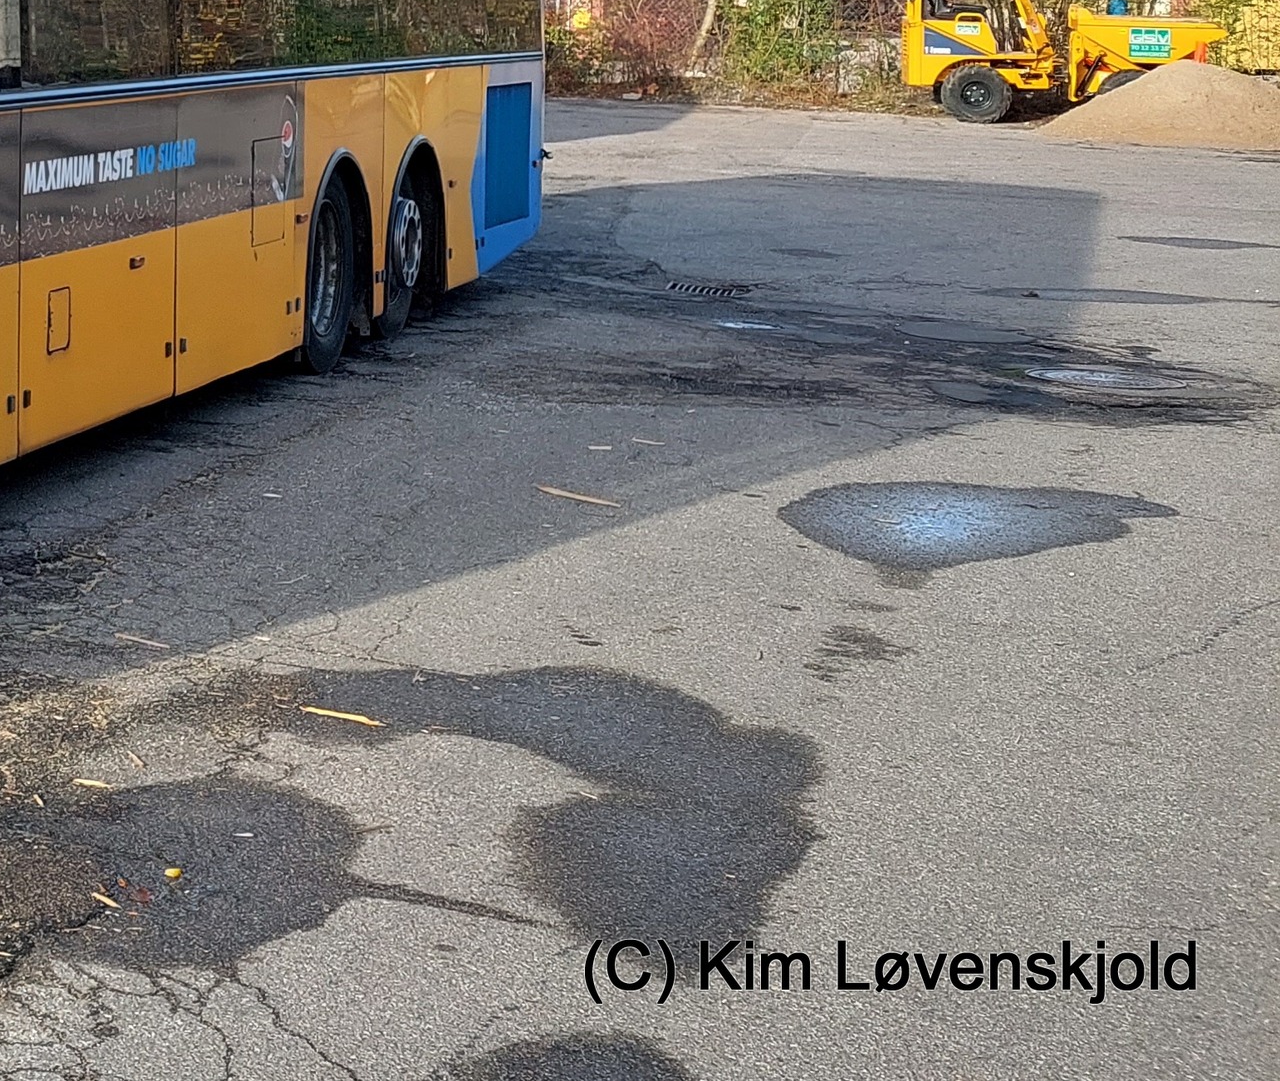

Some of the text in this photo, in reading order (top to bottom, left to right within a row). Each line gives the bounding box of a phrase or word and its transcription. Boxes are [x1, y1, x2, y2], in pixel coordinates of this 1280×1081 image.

[23, 138, 196, 195] MAXIMUM TASTE NO SUGAR
